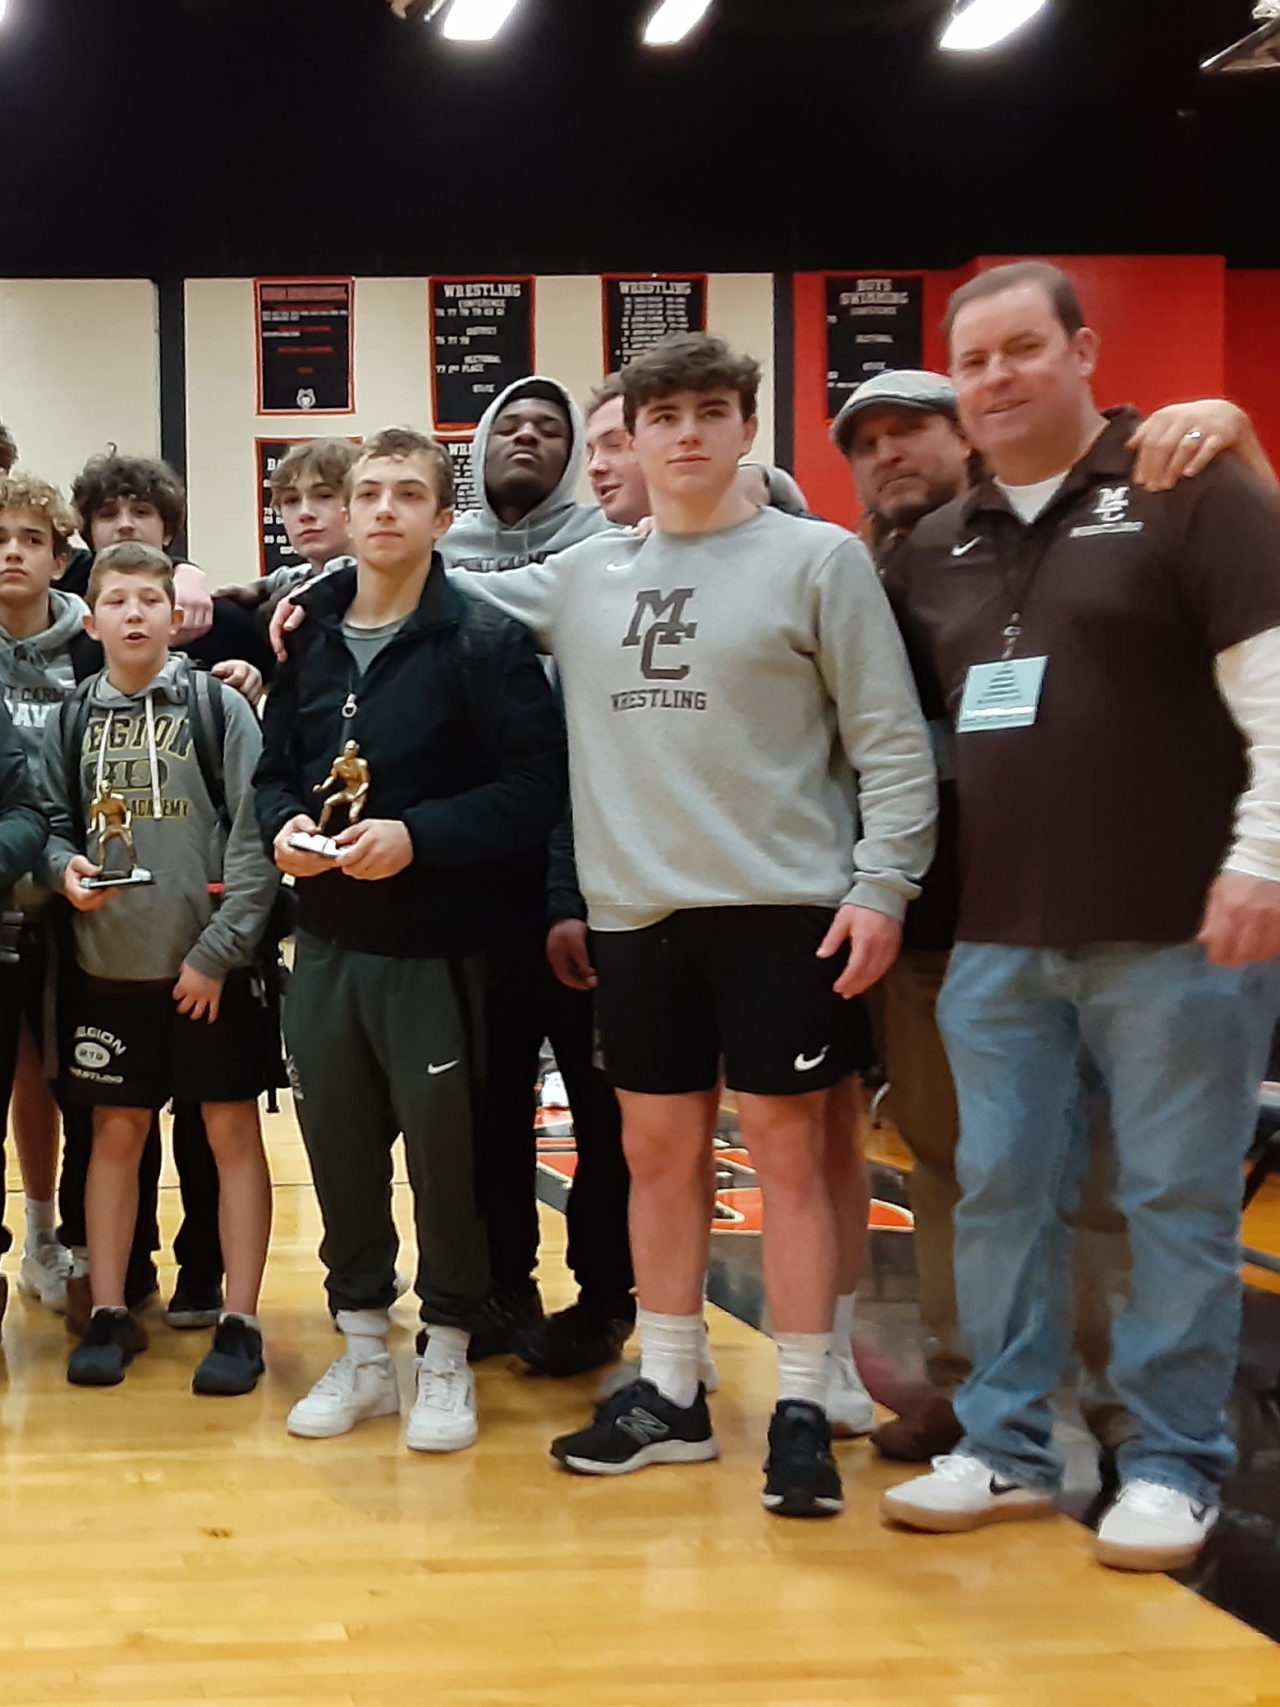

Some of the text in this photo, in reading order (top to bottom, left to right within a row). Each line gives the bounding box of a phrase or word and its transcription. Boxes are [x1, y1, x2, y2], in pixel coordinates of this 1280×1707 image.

[443, 283, 521, 297] WRESTLING
[610, 688, 708, 711] WRESTLING
[132, 799, 191, 817] ACAEMY
